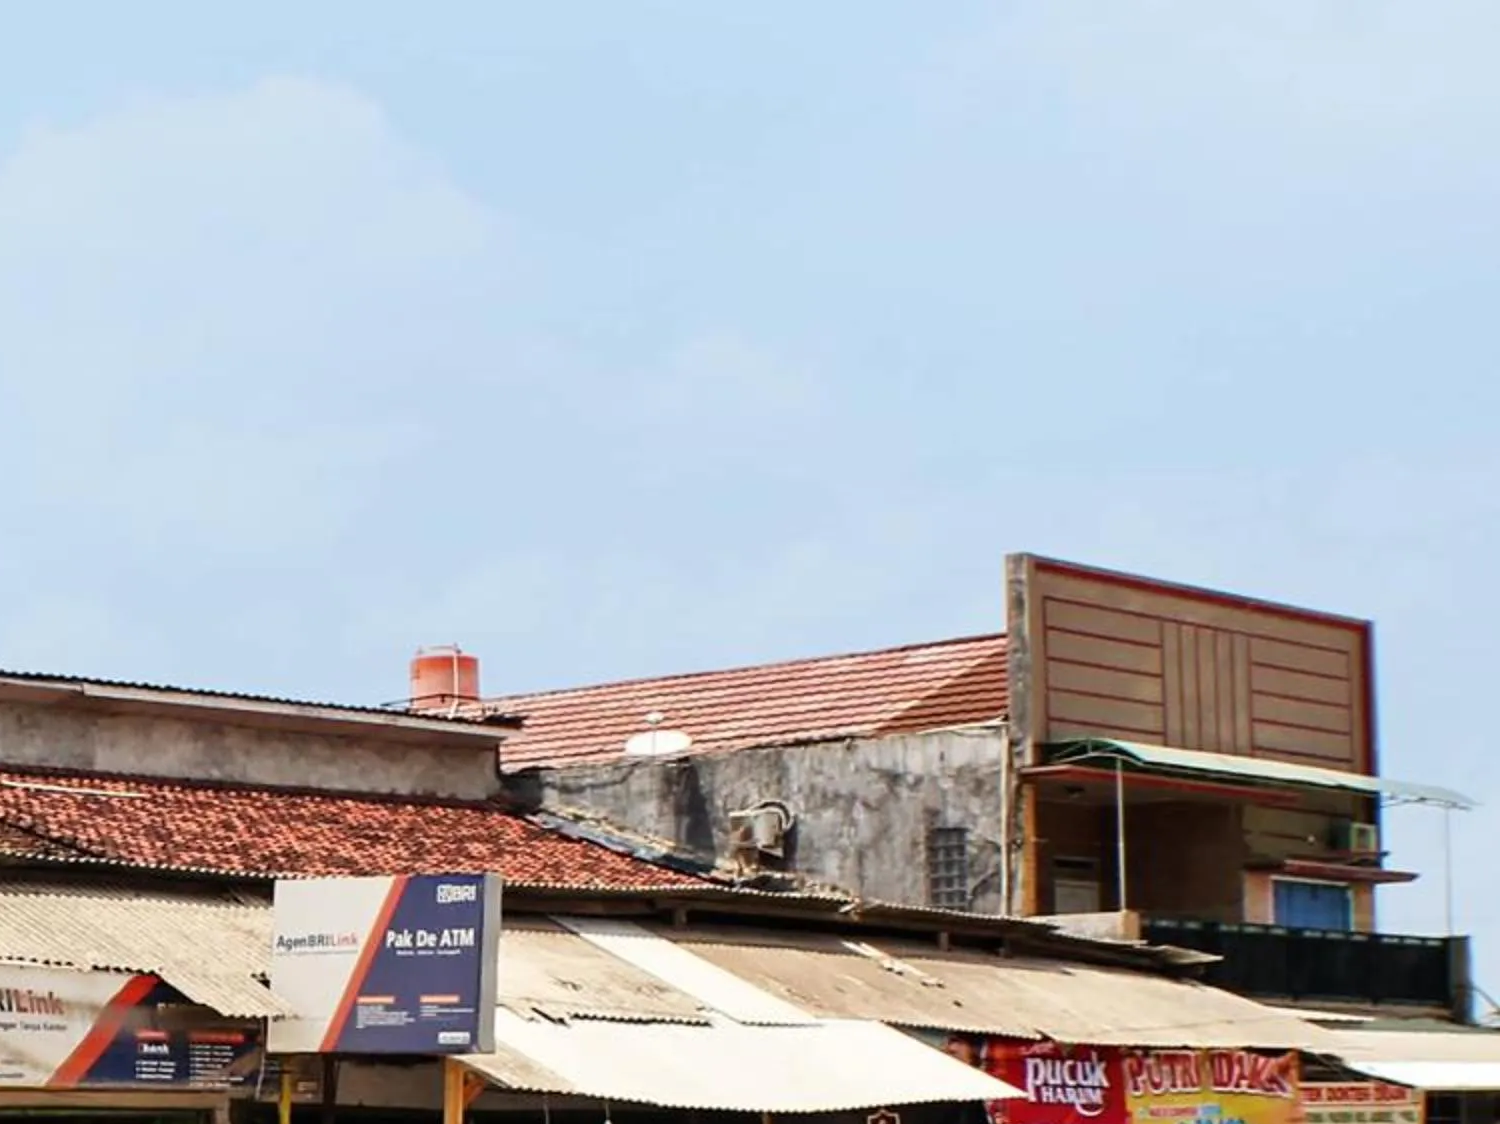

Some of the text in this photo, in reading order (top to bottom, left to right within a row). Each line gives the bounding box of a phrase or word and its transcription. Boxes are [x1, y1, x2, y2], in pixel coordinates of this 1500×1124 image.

[385, 927, 475, 949] Pak De ATM
